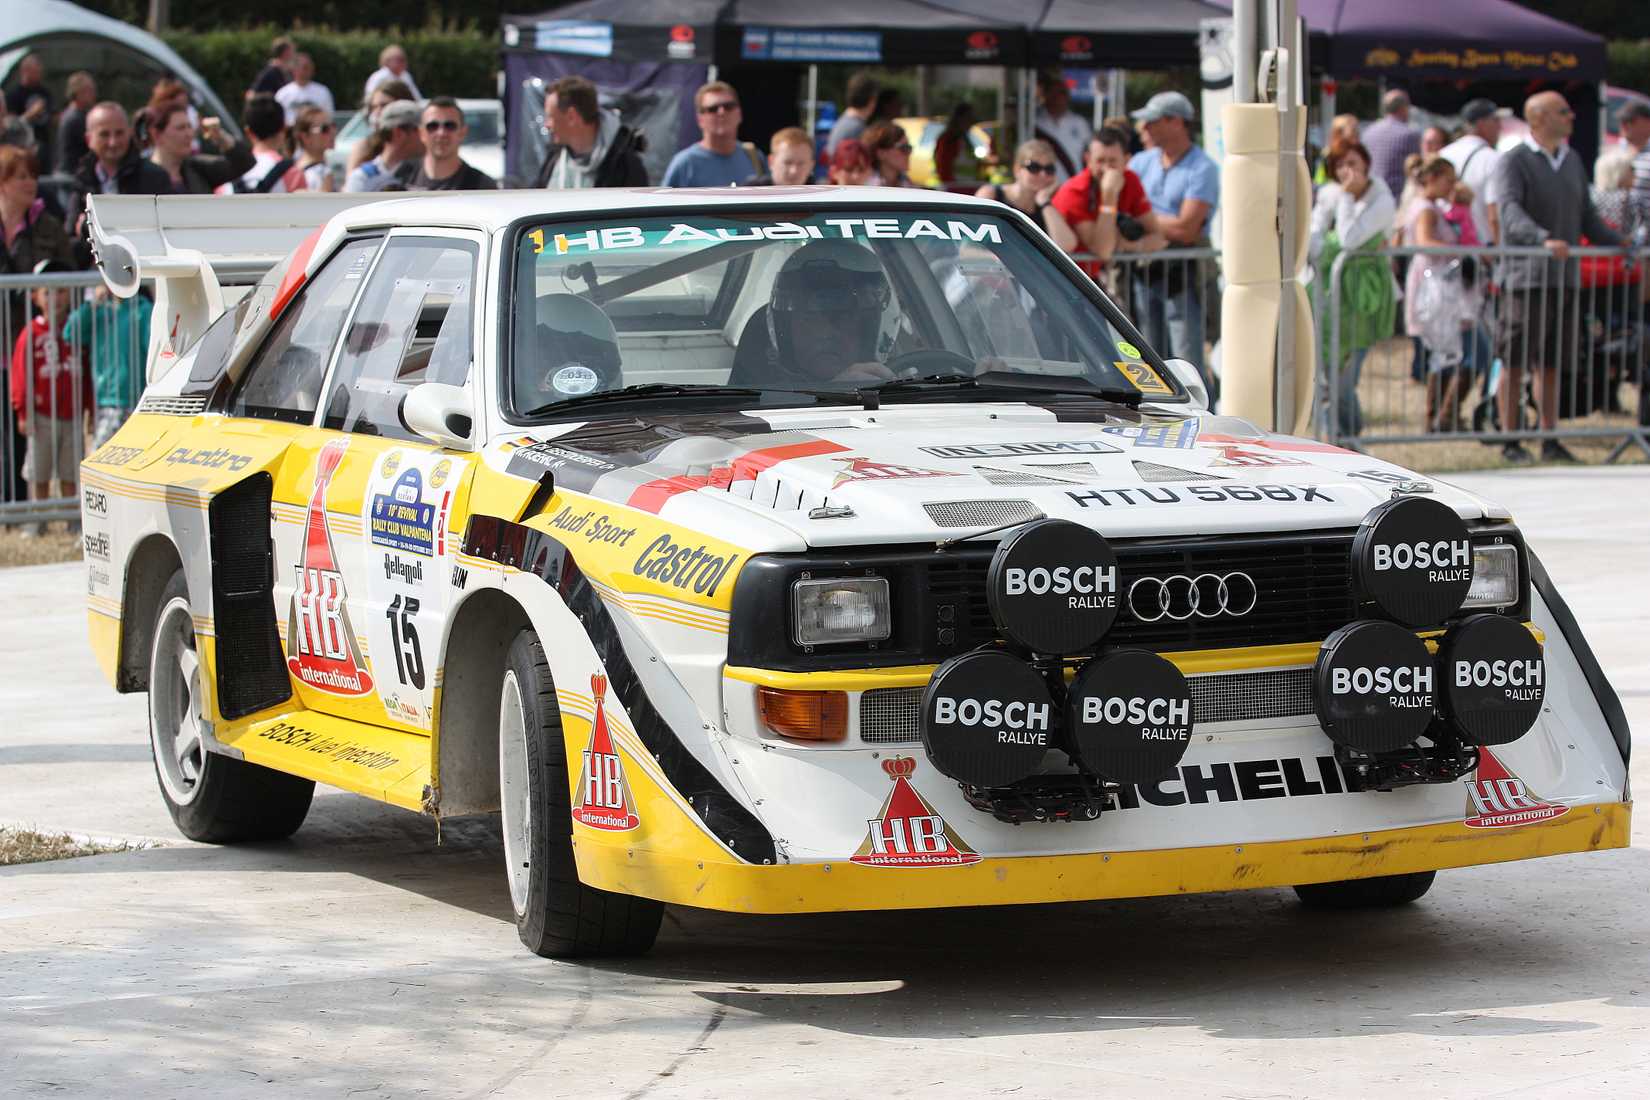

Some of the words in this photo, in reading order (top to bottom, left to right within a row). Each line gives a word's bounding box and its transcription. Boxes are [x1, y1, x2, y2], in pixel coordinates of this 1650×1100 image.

[554, 226, 645, 255] HB
[825, 219, 1002, 243] TEAM
[165, 447, 253, 472] quattro
[1065, 487, 1181, 508] HTU
[1190, 485, 1335, 502] 568X
[373, 519, 387, 532] RALLY
[387, 521, 400, 535] CLUB
[549, 506, 594, 533] Audi
[585, 515, 636, 547] Sport
[384, 553, 423, 585] Bellamoli
[633, 534, 739, 597] Castrol
[1374, 540, 1470, 571] BOSCH
[1006, 566, 1116, 595] BOSCH
[1429, 569, 1471, 582] RALLYE
[294, 565, 348, 661] HB
[1068, 596, 1116, 609] RALLYE
[386, 593, 426, 691] 15
[299, 662, 362, 692] international
[1332, 666, 1433, 694] BOSCH
[1455, 659, 1543, 687] BOSCH
[1389, 695, 1432, 708] RALLYE
[1505, 688, 1542, 701] RALLYE
[935, 696, 1050, 730] BOSCH
[1082, 696, 1190, 726] BOSCH
[259, 723, 322, 747] BOSCH
[305, 736, 352, 754] fuel
[332, 742, 399, 769] injection
[998, 731, 1047, 745] RALLYE
[1141, 727, 1188, 741] RALLYE
[583, 750, 623, 809] HB
[1463, 778, 1538, 815] HB
[581, 811, 629, 828] international
[1481, 807, 1555, 827] international
[867, 815, 949, 855] HB
[869, 853, 963, 864] international
